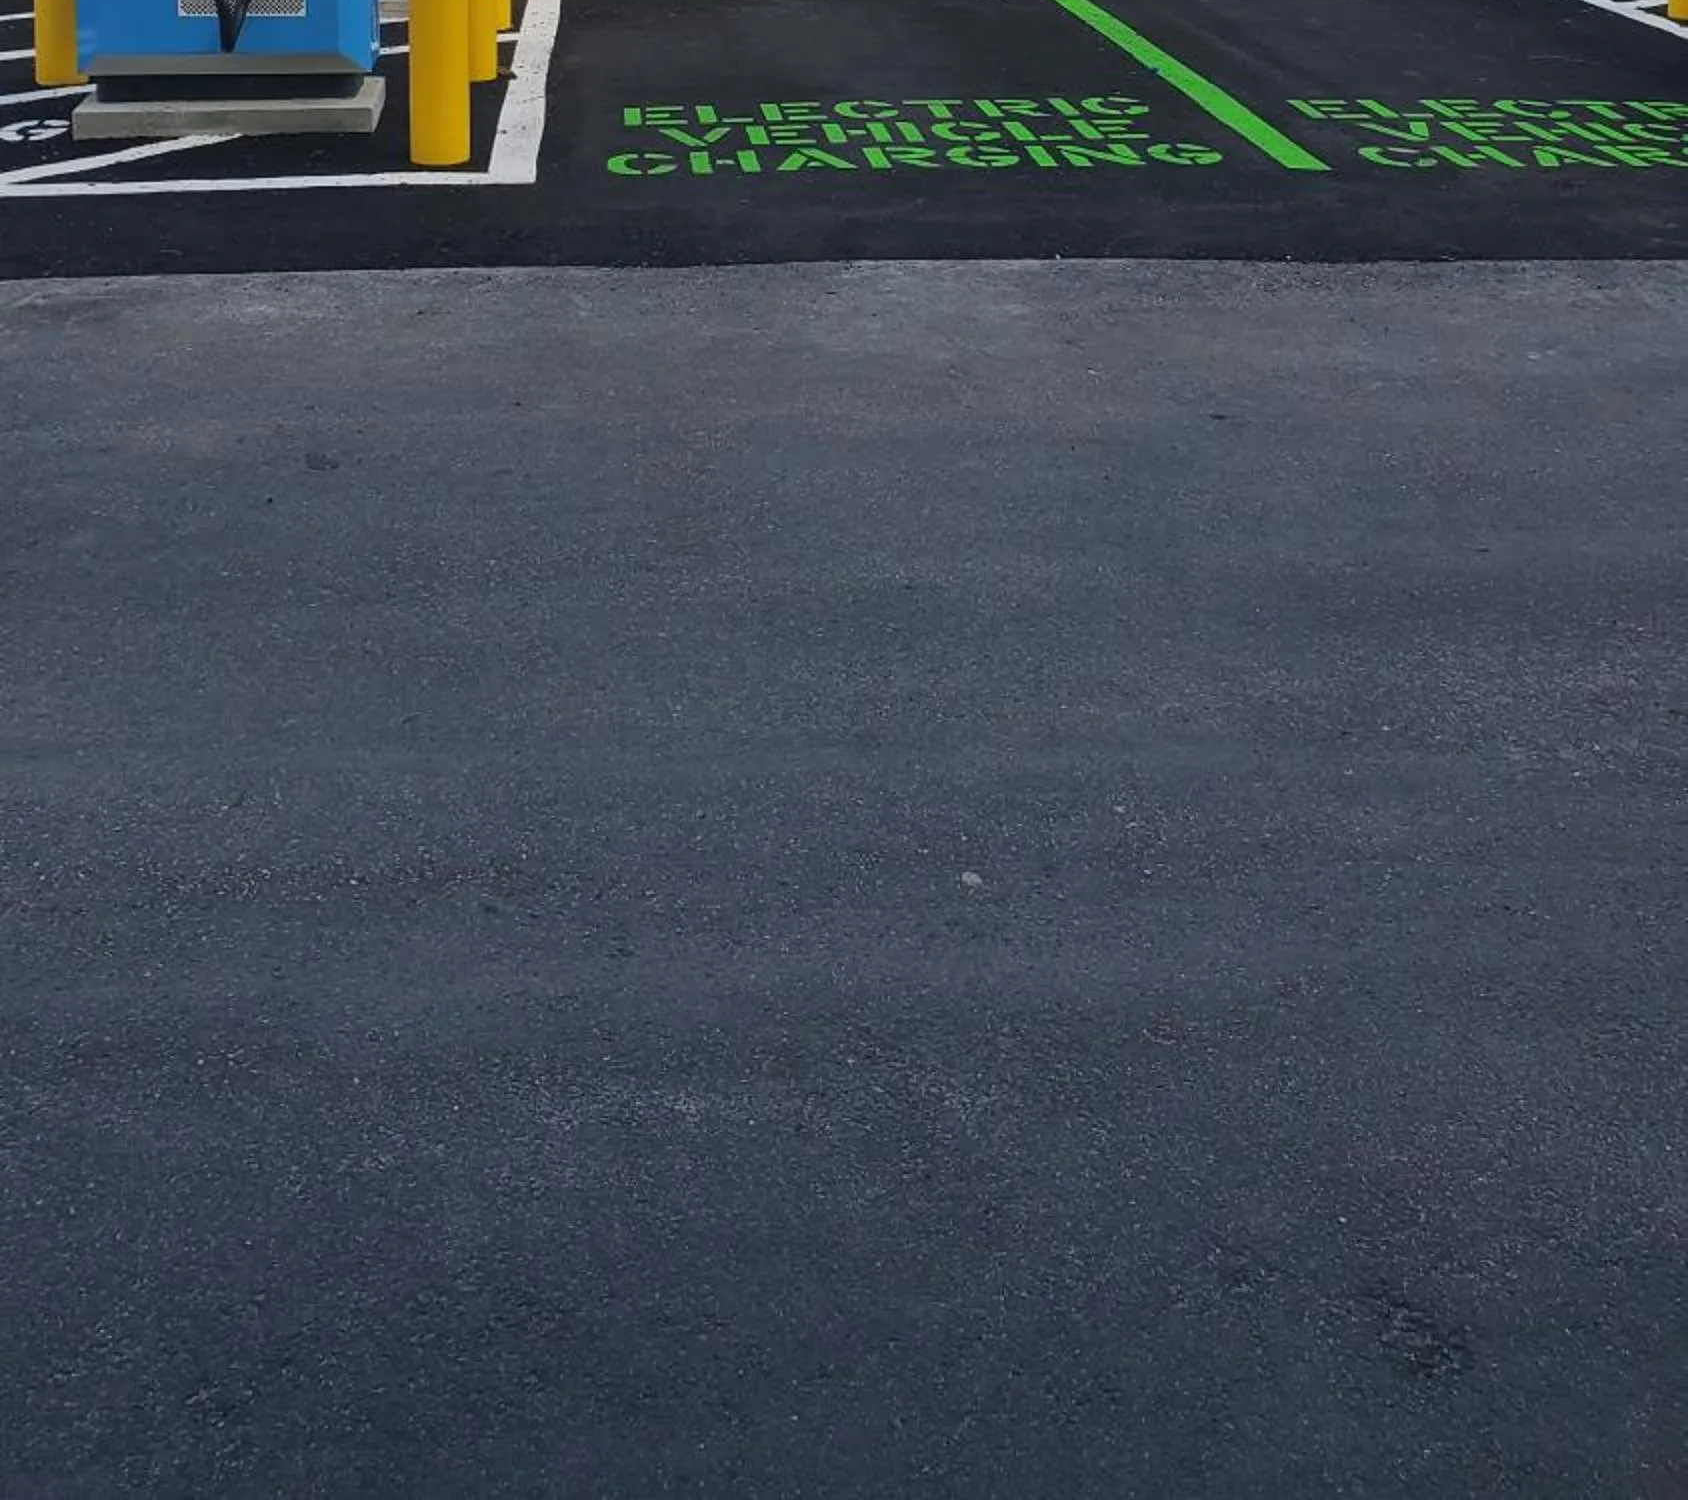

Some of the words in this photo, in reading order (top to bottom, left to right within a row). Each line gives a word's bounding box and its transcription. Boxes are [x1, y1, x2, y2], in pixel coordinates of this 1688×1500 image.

[623, 97, 1150, 127] ELECTRIC
[658, 120, 1151, 148] VEHICLE
[606, 143, 1223, 176] CHARGING
[1357, 145, 1688, 168] CHAR
